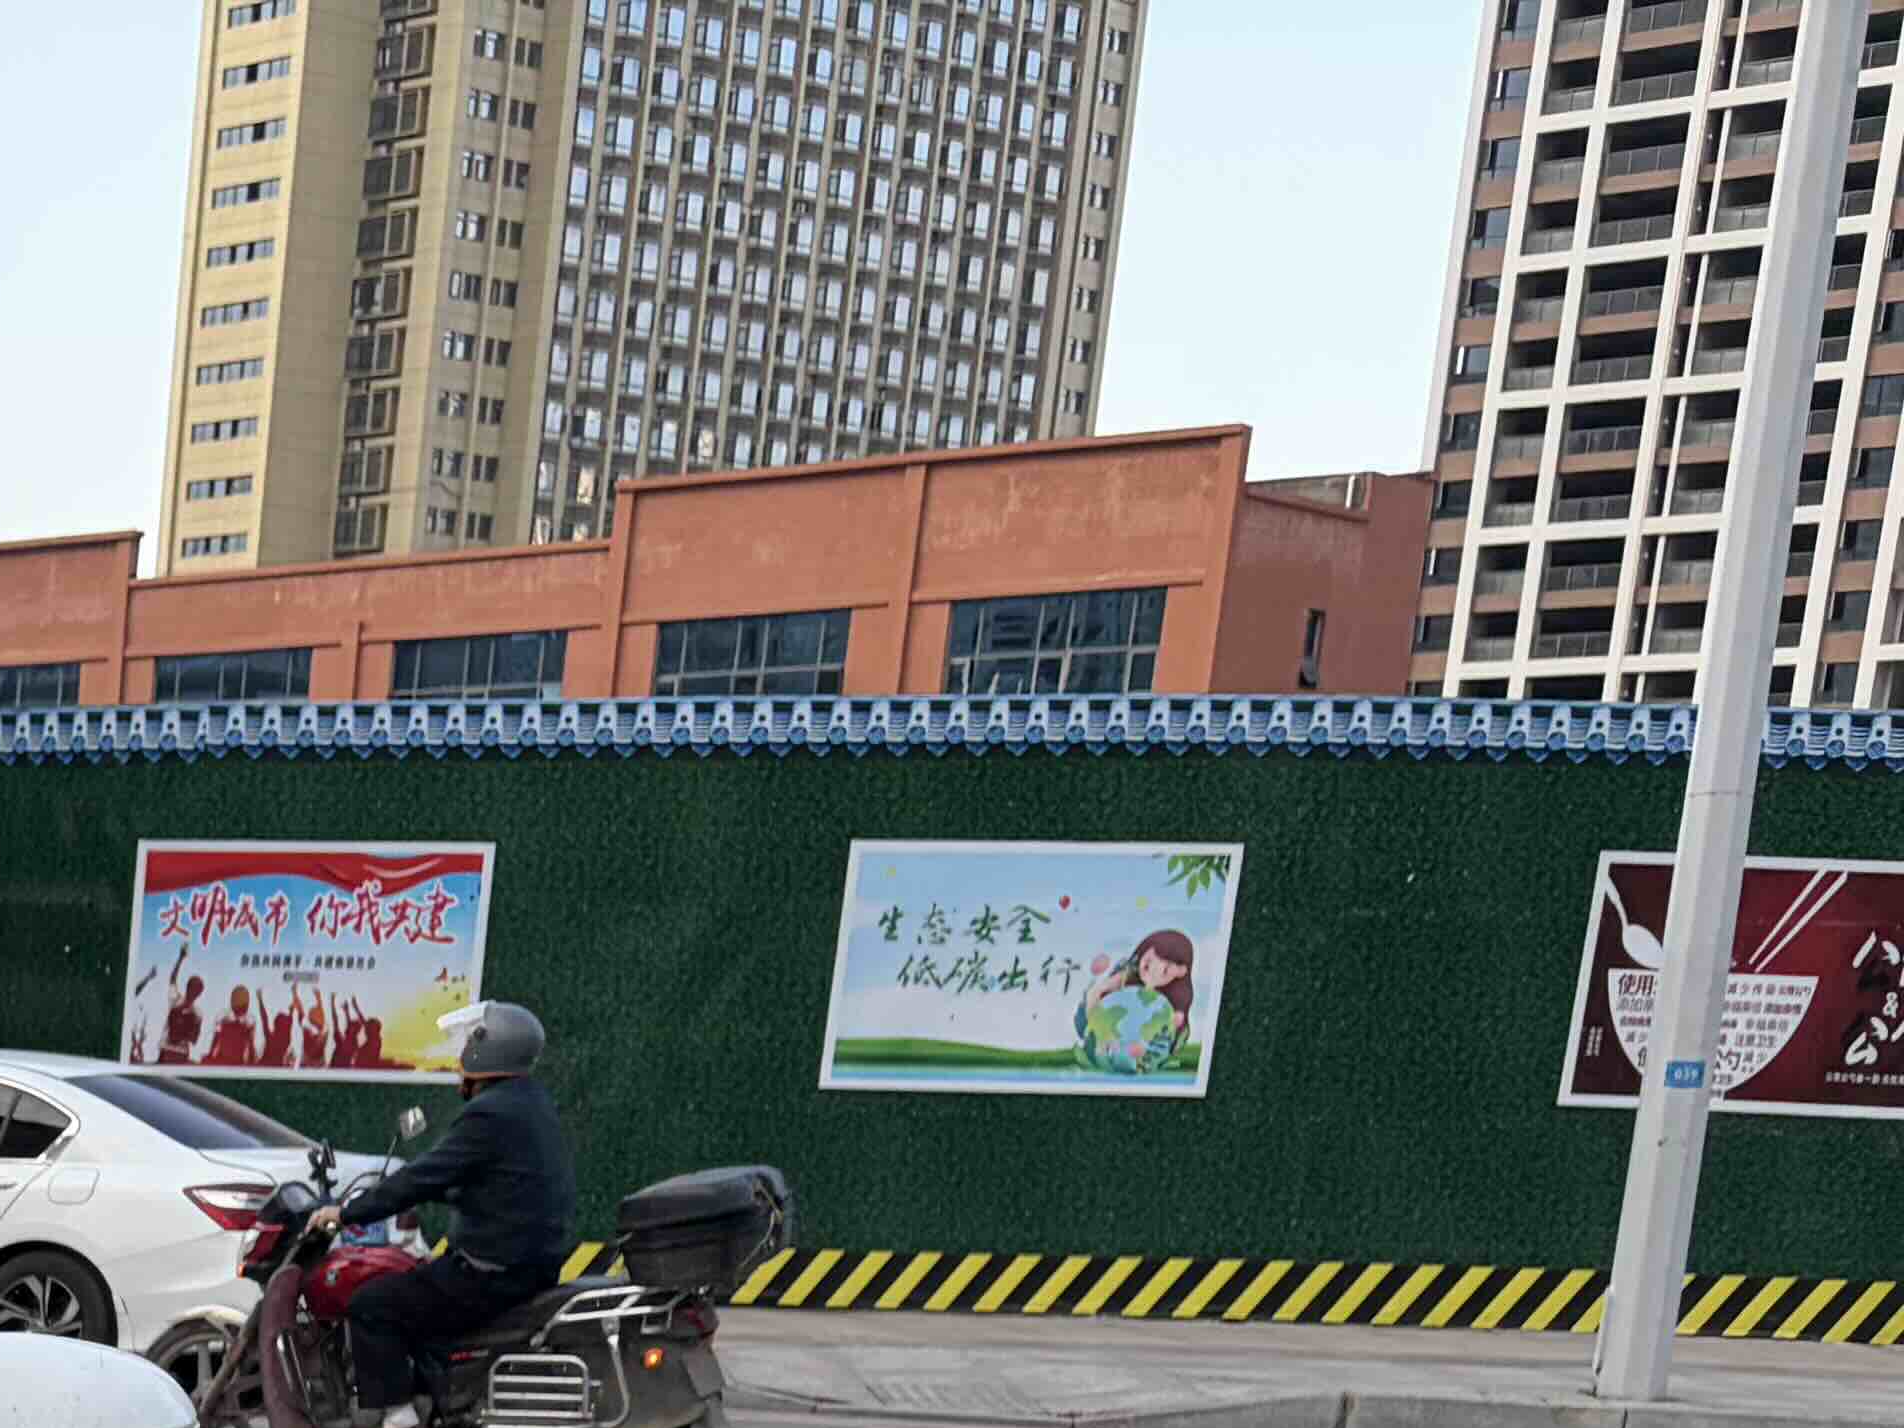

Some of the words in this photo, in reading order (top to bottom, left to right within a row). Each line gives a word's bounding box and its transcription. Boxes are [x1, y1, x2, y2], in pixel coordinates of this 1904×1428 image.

[160, 883, 290, 947] 文明城市
[307, 876, 459, 945] 你我共建
[877, 903, 1051, 945] 生态安全
[896, 951, 1082, 995] 低碳出行
